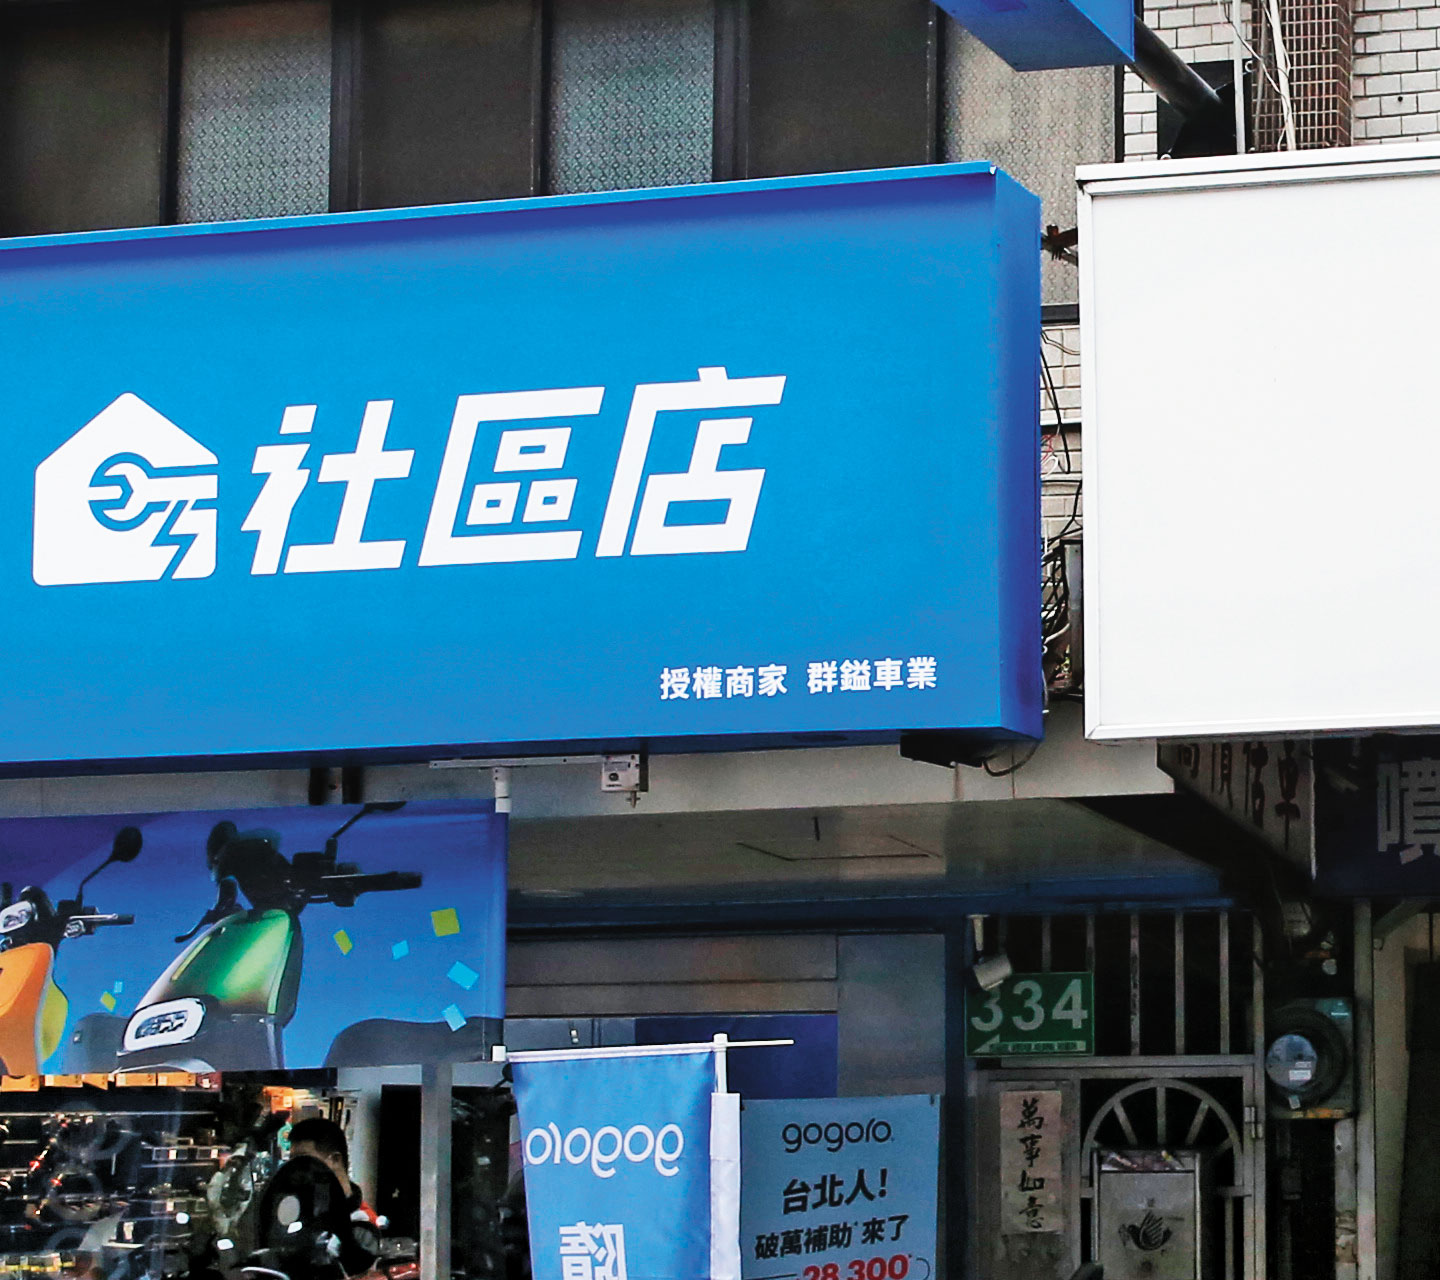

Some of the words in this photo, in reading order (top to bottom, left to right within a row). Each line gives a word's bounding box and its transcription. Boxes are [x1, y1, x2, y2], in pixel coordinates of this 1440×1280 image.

[241, 365, 787, 576] 社區店
[658, 663, 788, 700] 授權商家
[806, 656, 938, 694] 群鎰車業
[971, 978, 1088, 1031] 334
[782, 1118, 892, 1154] gogoro
[783, 1168, 888, 1215] 台北人!
